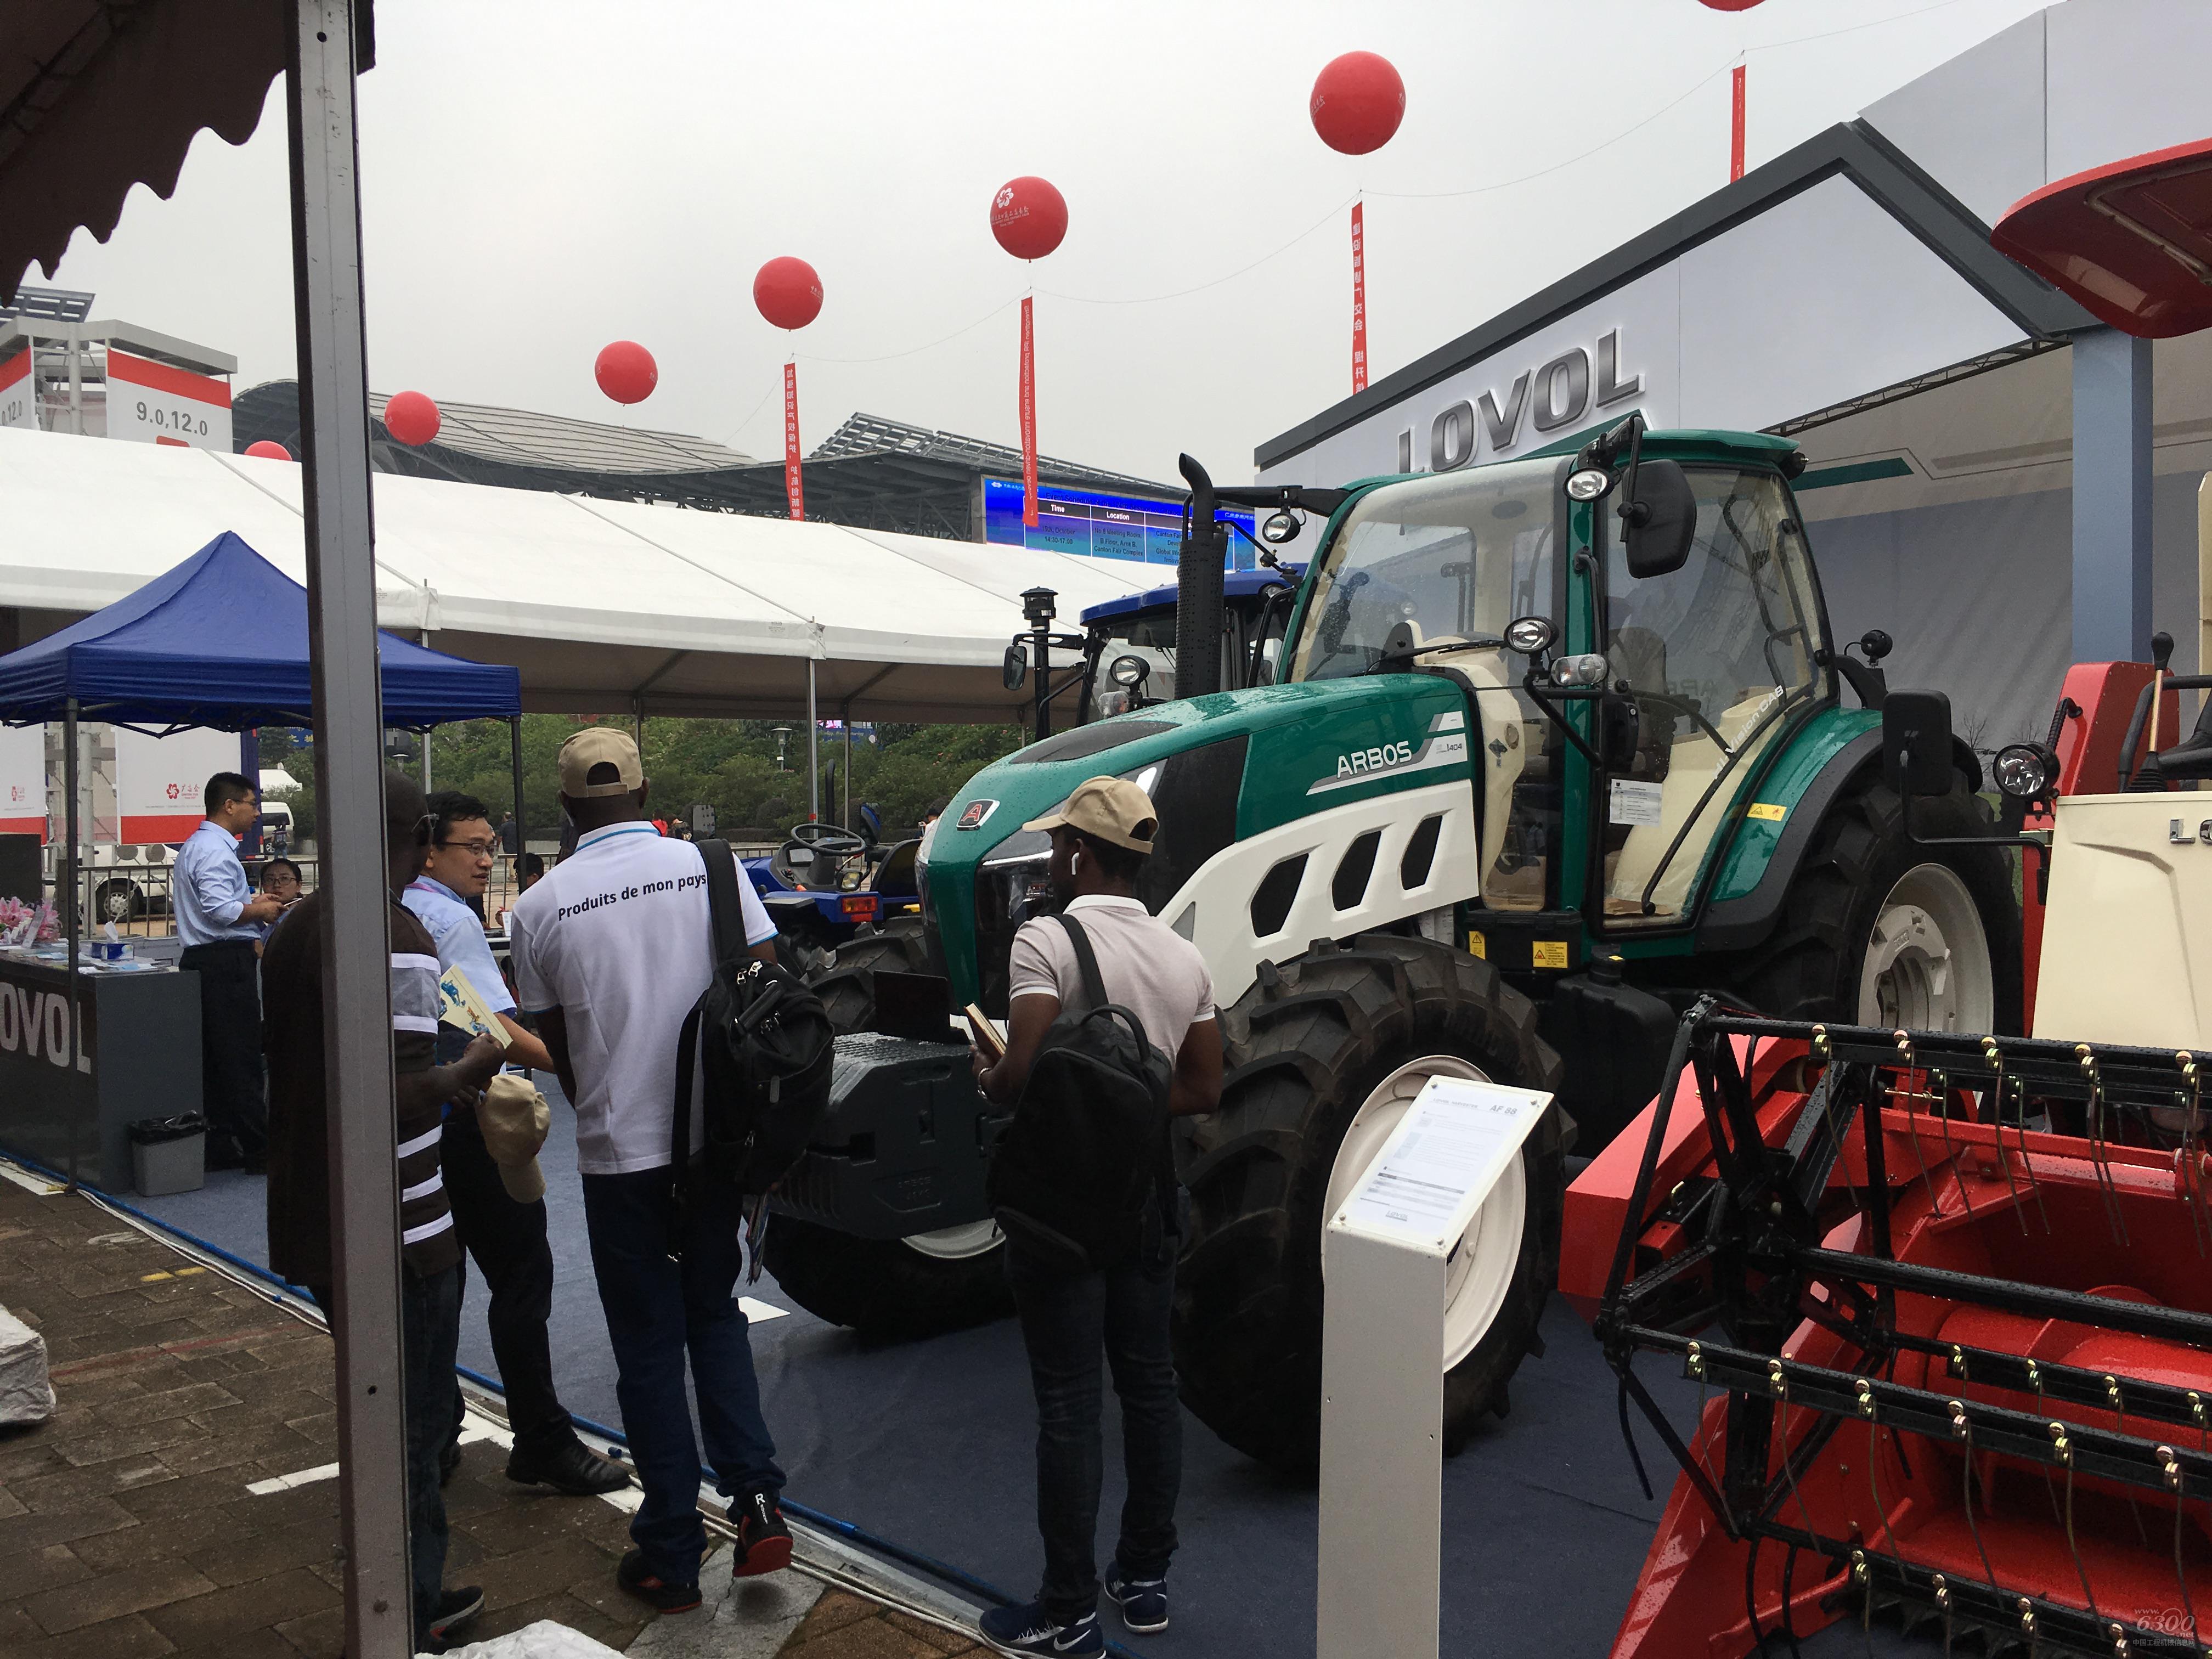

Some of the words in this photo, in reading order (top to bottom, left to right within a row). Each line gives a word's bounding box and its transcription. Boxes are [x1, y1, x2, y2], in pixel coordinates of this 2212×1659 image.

[1398, 327, 1645, 473] LOVOL
[137, 402, 208, 436] 9.0,12.0
[1051, 504, 1065, 512] Time
[1107, 511, 1130, 520] Location
[1045, 537, 1073, 545] 14:30-17:00
[1759, 685, 1784, 713] CAB
[1337, 741, 1412, 778] ARBOS
[558, 893, 617, 921] Produits
[621, 887, 638, 900] de
[643, 879, 673, 895] mon
[678, 874, 707, 891] pays
